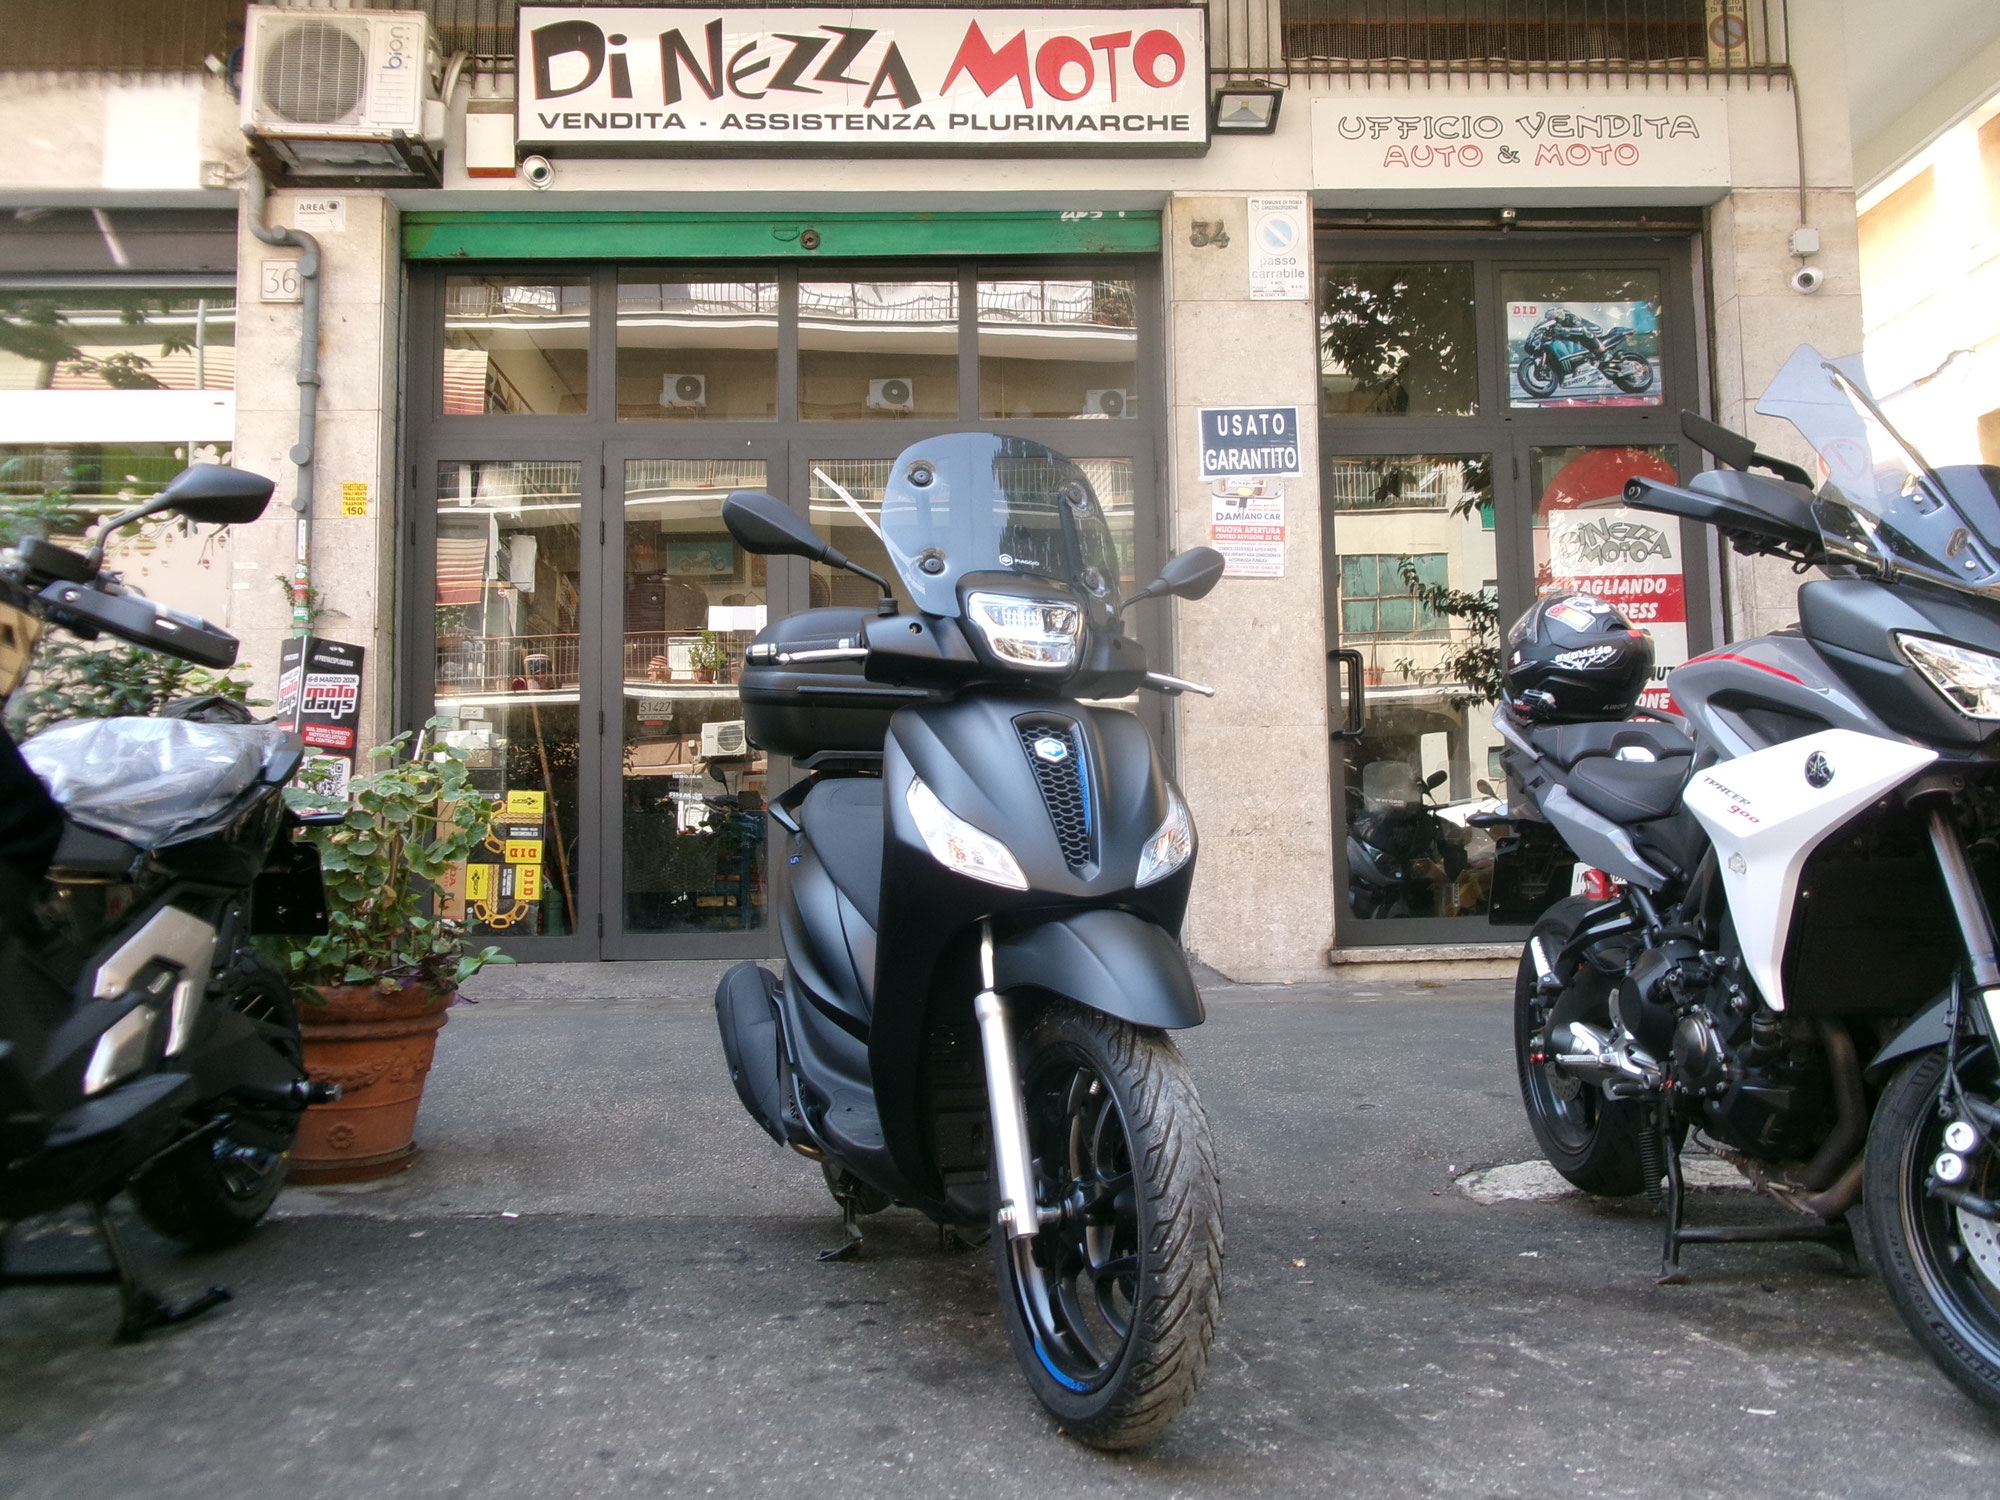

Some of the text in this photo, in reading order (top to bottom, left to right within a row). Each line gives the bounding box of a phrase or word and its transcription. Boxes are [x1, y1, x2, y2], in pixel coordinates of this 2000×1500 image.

[939, 18, 1186, 109] MOTO
[537, 112, 687, 130] VENDITA
[720, 113, 936, 131] ASSISTENZA
[949, 114, 1190, 132] PLURIMARCHE
[1337, 111, 1701, 140] UFFICIO VENDITA
[1383, 143, 1640, 168] AUTO & MOTO
[299, 203, 325, 211] AREA
[1260, 257, 1297, 268] passo
[264, 267, 298, 294] 36
[1251, 268, 1305, 279] carrabile
[1512, 305, 1537, 315] DID
[1217, 413, 1285, 437] USATO
[1205, 446, 1297, 471] GARANTITO
[1215, 512, 1281, 521] DAMIANO CAR
[1244, 526, 1281, 534] APERTURA
[1578, 540, 1649, 566] MOTO
[1014, 558, 1040, 567] PIAGGIO
[1571, 577, 1667, 595] TAGLIANDO
[306, 684, 356, 698] moto
[304, 699, 355, 716] days
[640, 701, 671, 712] 51427
[1703, 775, 1752, 805] TRACER
[1727, 804, 1760, 824] 900
[510, 848, 537, 858] DID
[523, 869, 535, 896] DID
